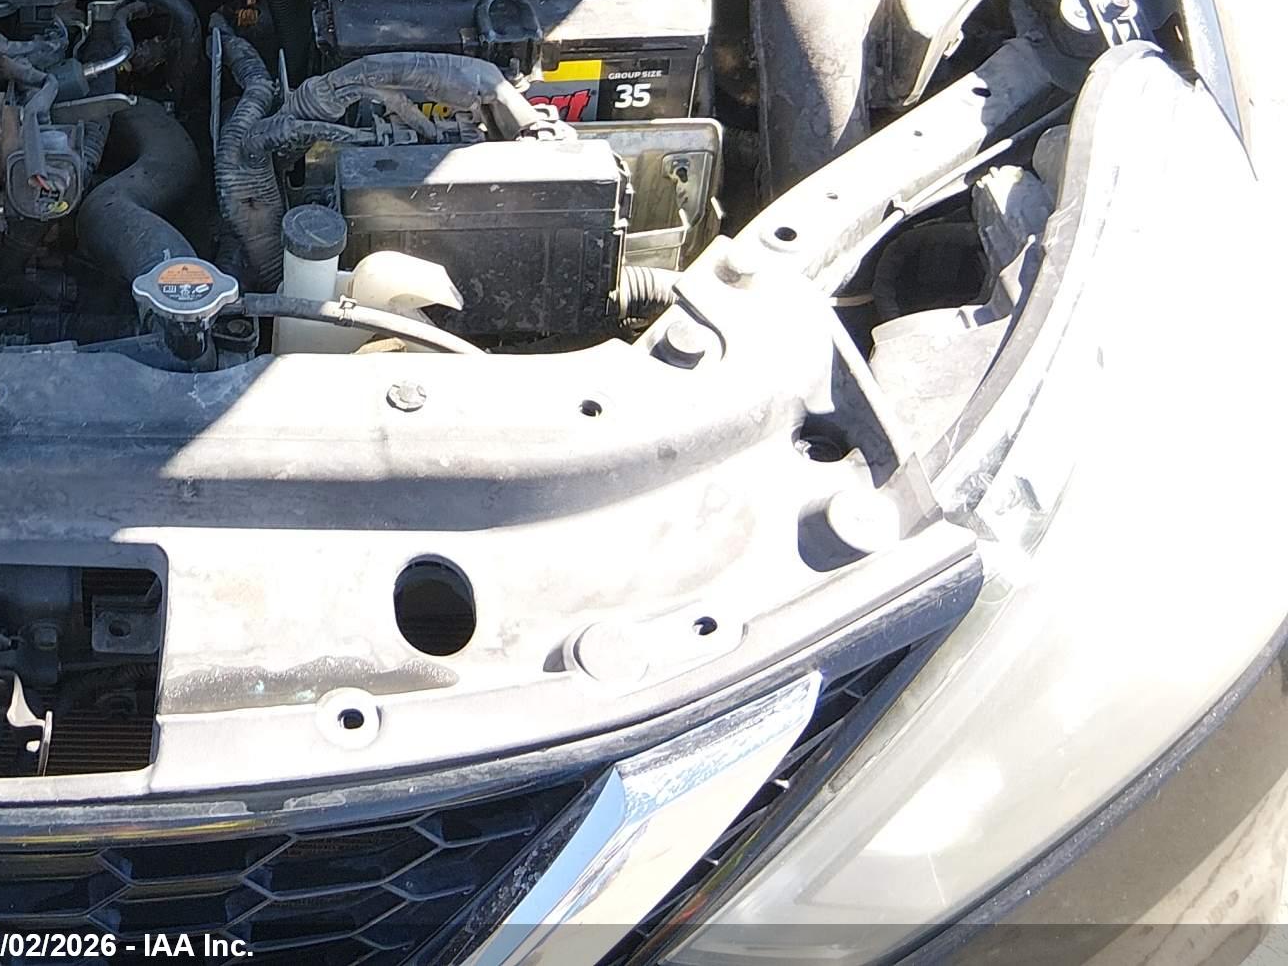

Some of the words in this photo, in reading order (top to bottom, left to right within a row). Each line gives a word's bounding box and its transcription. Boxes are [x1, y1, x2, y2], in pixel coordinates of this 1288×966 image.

[608, 70, 640, 80] GROUP
[641, 69, 662, 78] SIZE
[614, 83, 651, 109] 35
